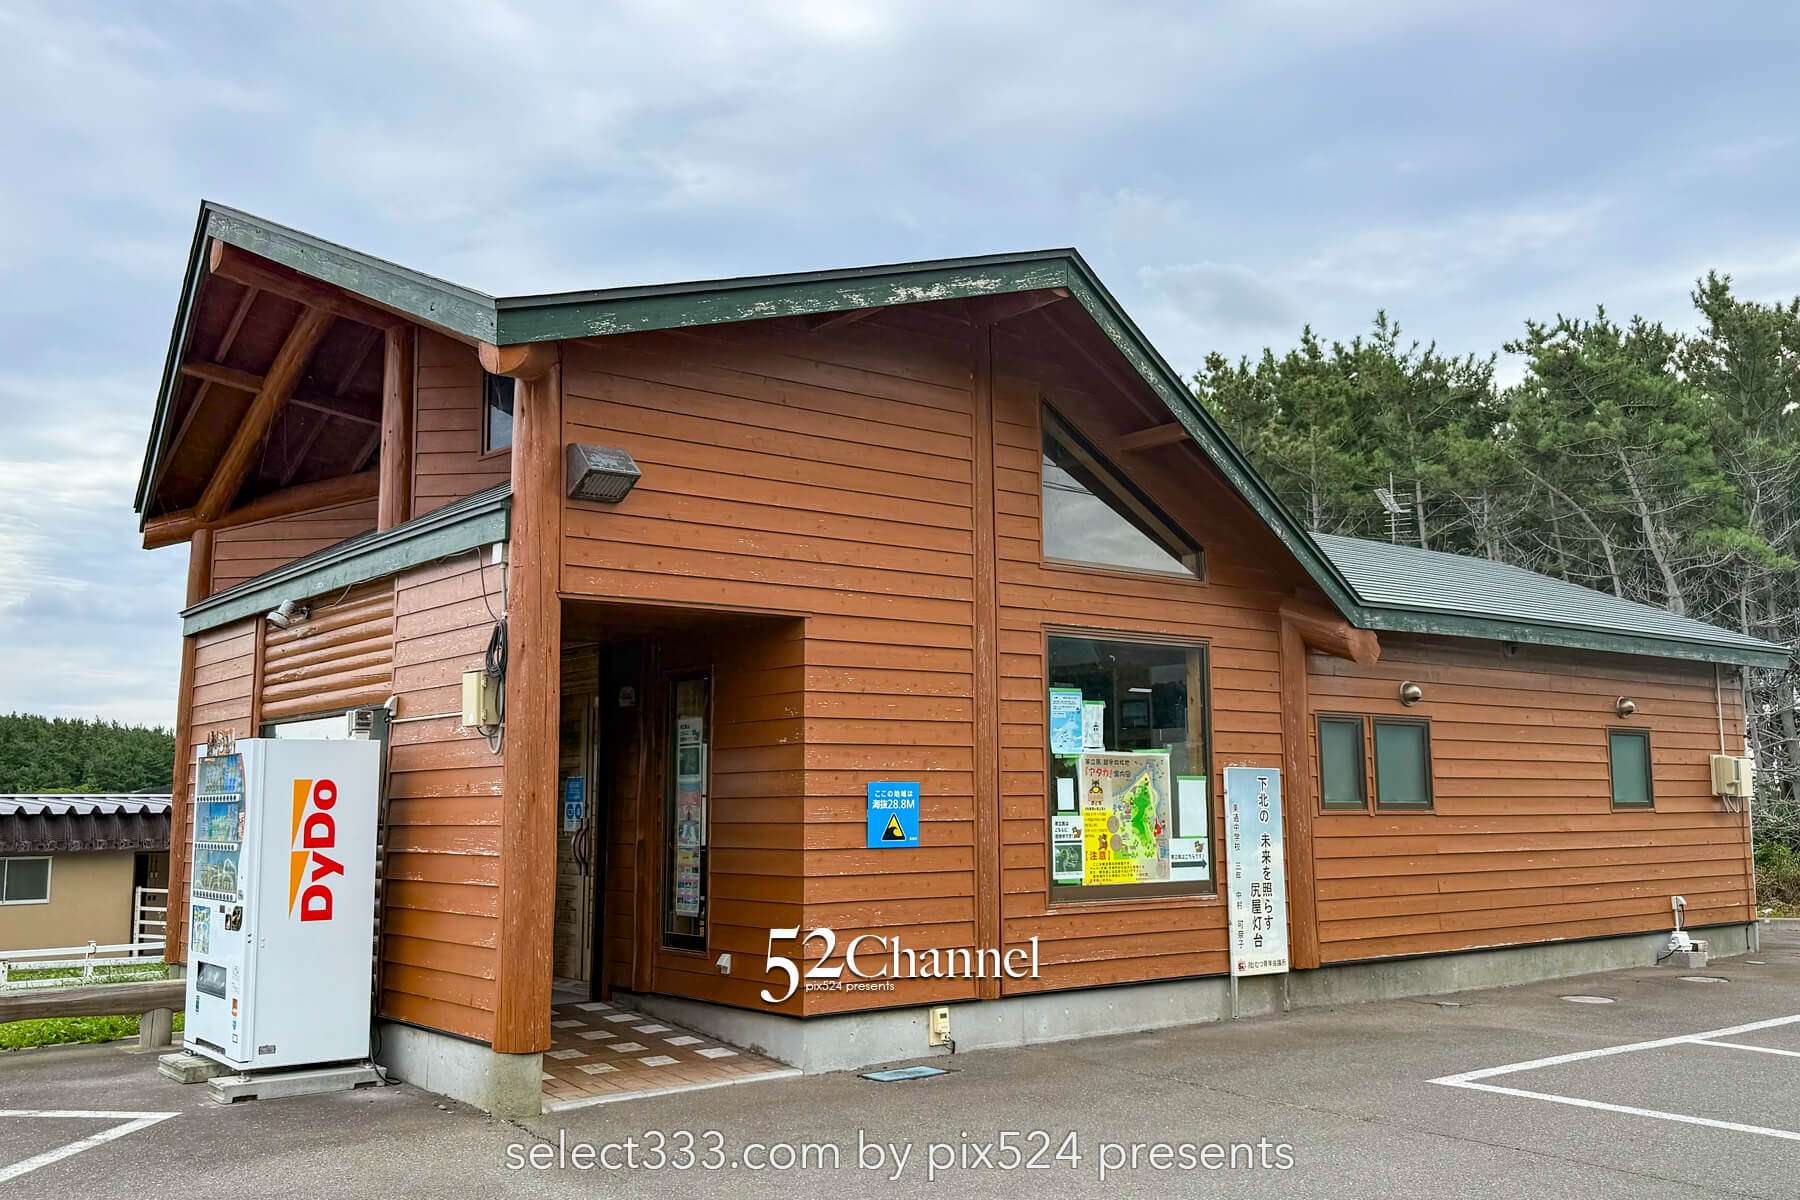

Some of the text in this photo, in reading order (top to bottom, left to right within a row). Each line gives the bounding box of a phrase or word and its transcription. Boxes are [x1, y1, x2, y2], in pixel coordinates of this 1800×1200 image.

[874, 790, 913, 798] ここの地域は
[300, 778, 344, 922] DyDo
[1257, 776, 1274, 930] 下北の 未来を照らす
[1250, 882, 1264, 948] 尻屋灯台
